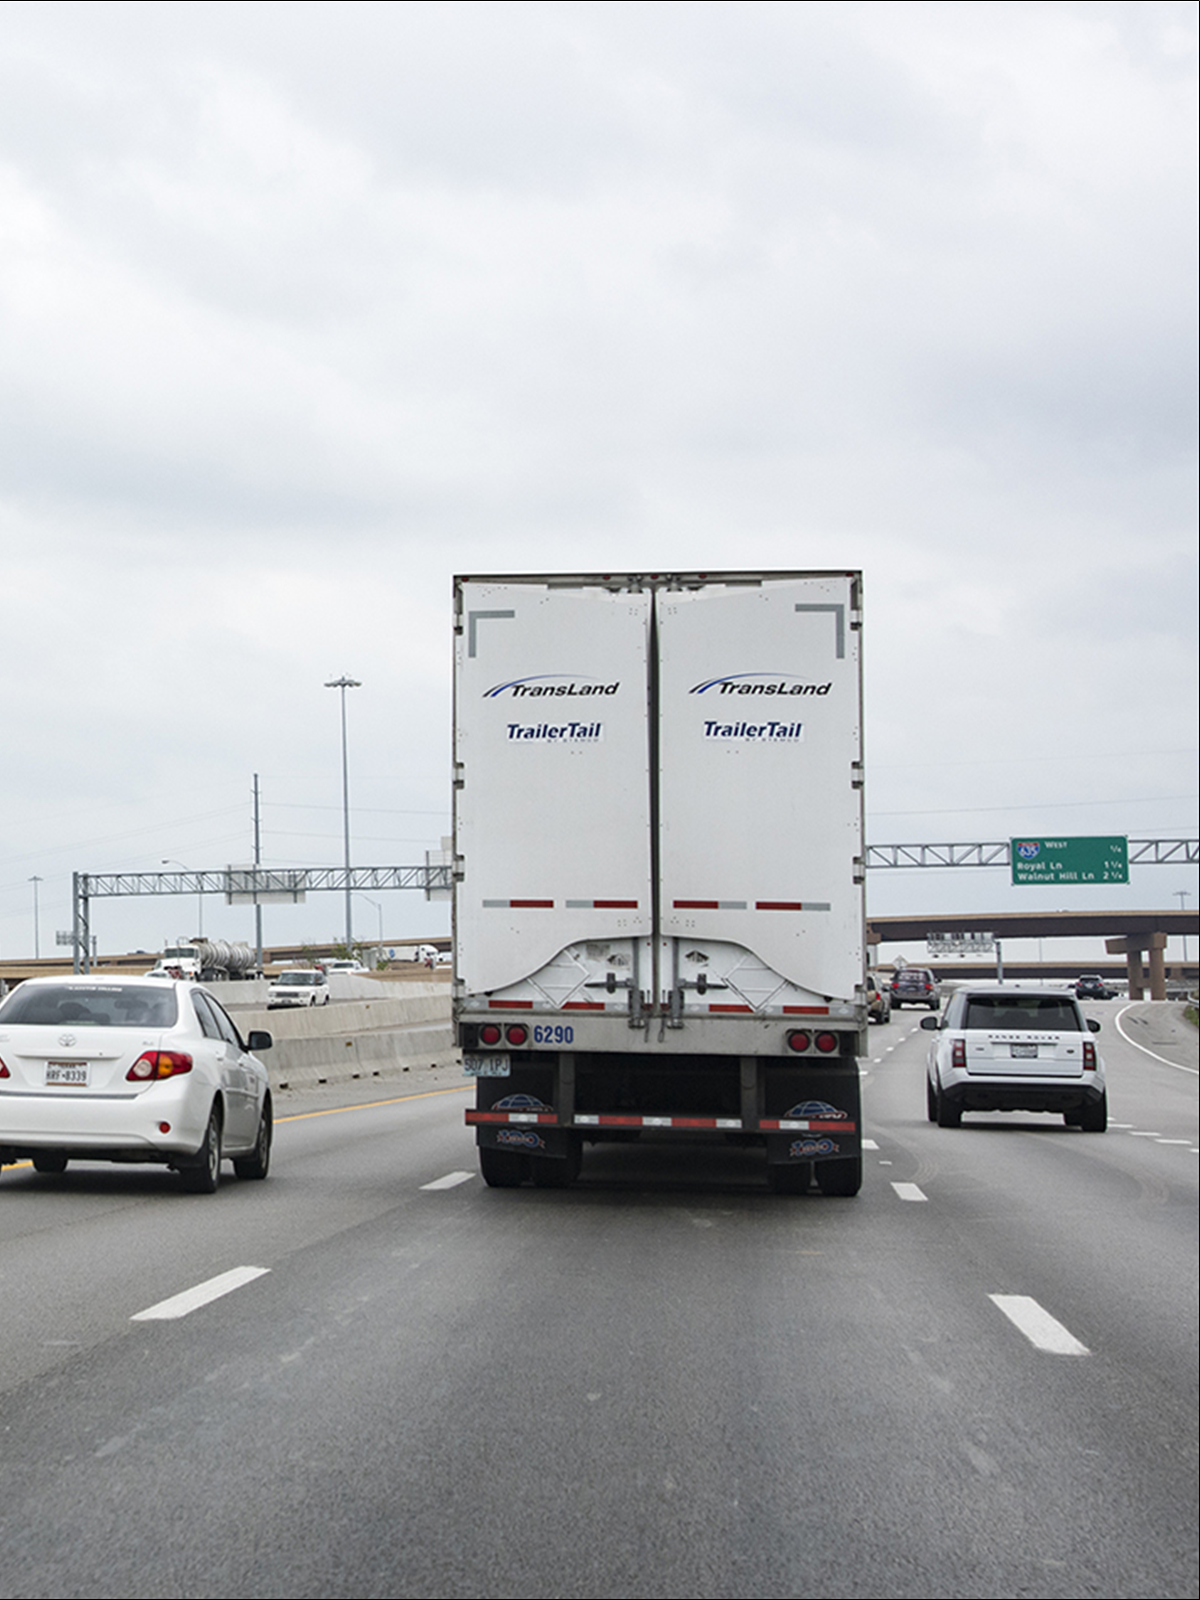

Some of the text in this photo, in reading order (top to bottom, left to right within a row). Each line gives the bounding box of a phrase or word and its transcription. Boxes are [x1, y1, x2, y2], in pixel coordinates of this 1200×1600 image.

[511, 681, 620, 698] TransLand
[719, 681, 833, 697] TransLand
[507, 722, 602, 739] TrailerTail
[704, 721, 803, 738] TrailerTail
[1020, 846, 1039, 857] 635
[1017, 861, 1063, 871] Royal Ln
[1017, 872, 1095, 881] Walnut Hill Ln
[533, 1025, 574, 1044] 6290
